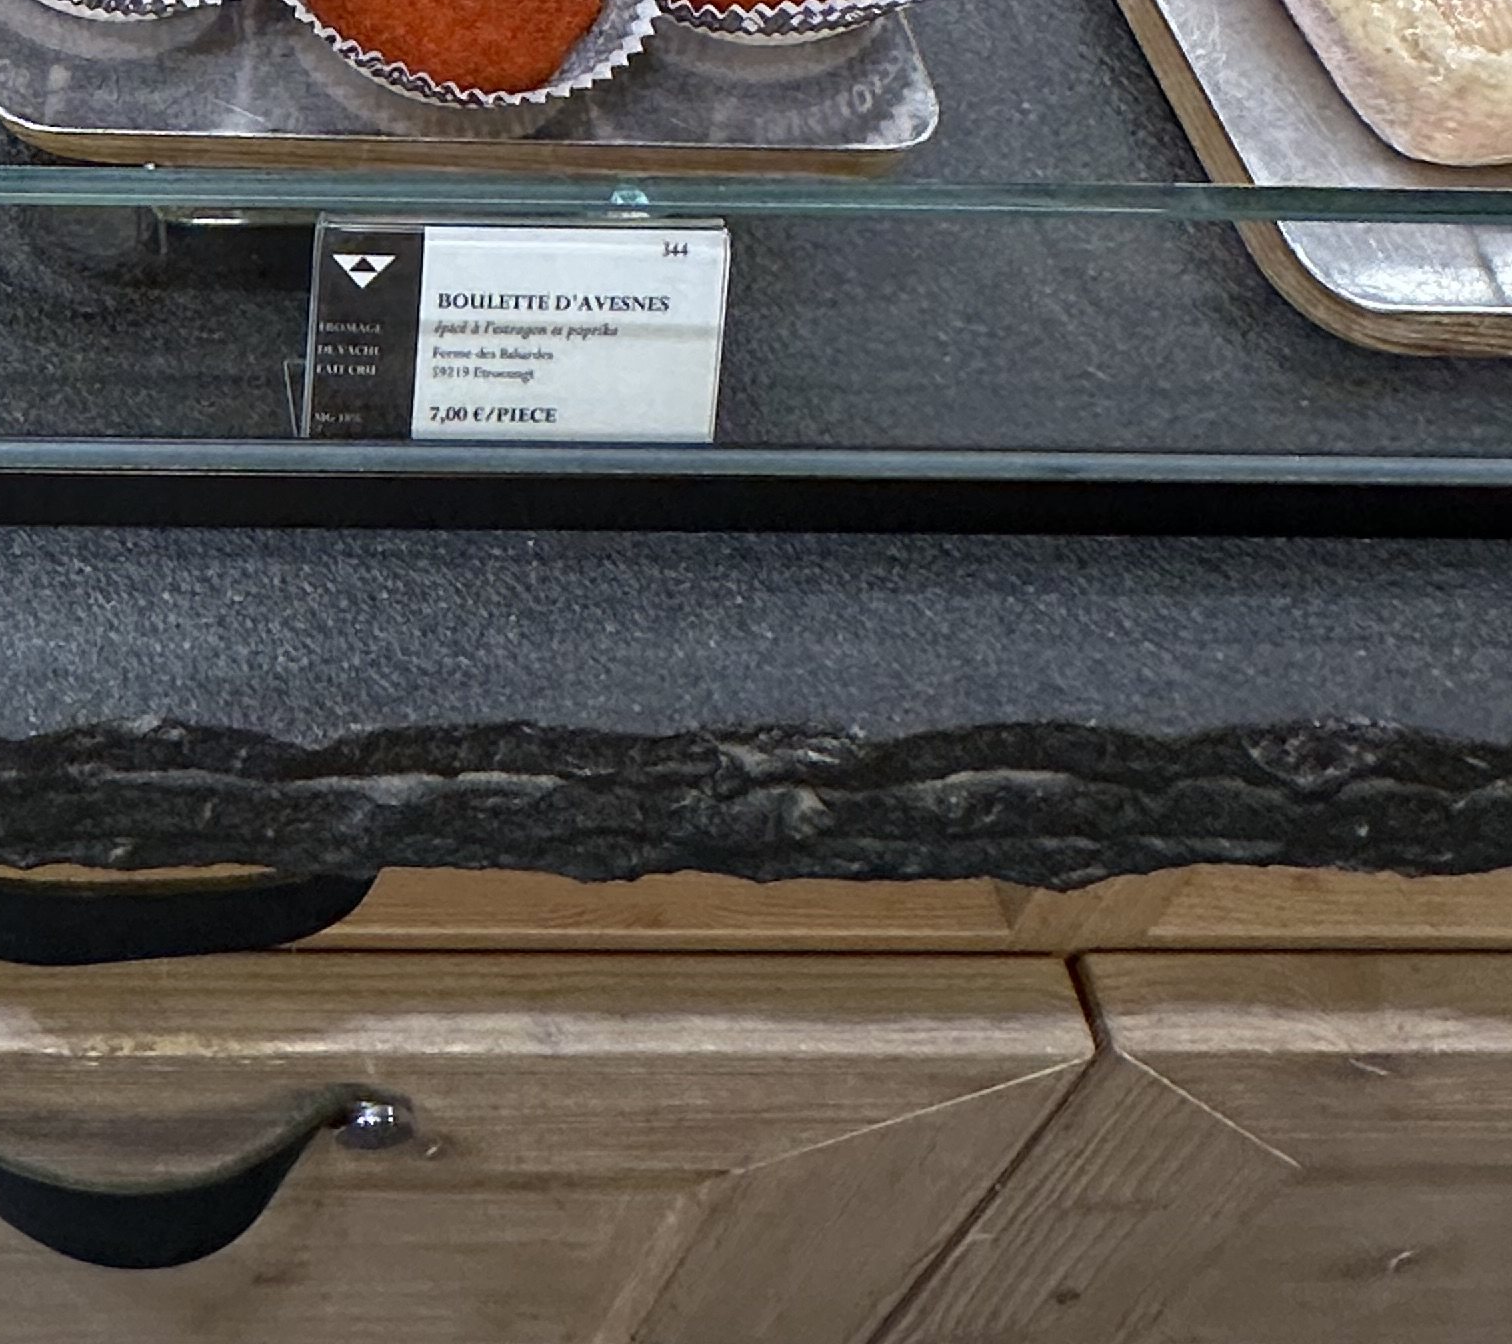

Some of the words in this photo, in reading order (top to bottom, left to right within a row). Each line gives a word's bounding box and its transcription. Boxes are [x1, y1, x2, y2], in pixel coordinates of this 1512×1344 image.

[663, 241, 688, 258] 344
[438, 293, 550, 312] BOULETTE
[554, 293, 670, 313] D'AVESNES
[429, 407, 468, 426] 7,00
[473, 406, 557, 424] €/PIECE
